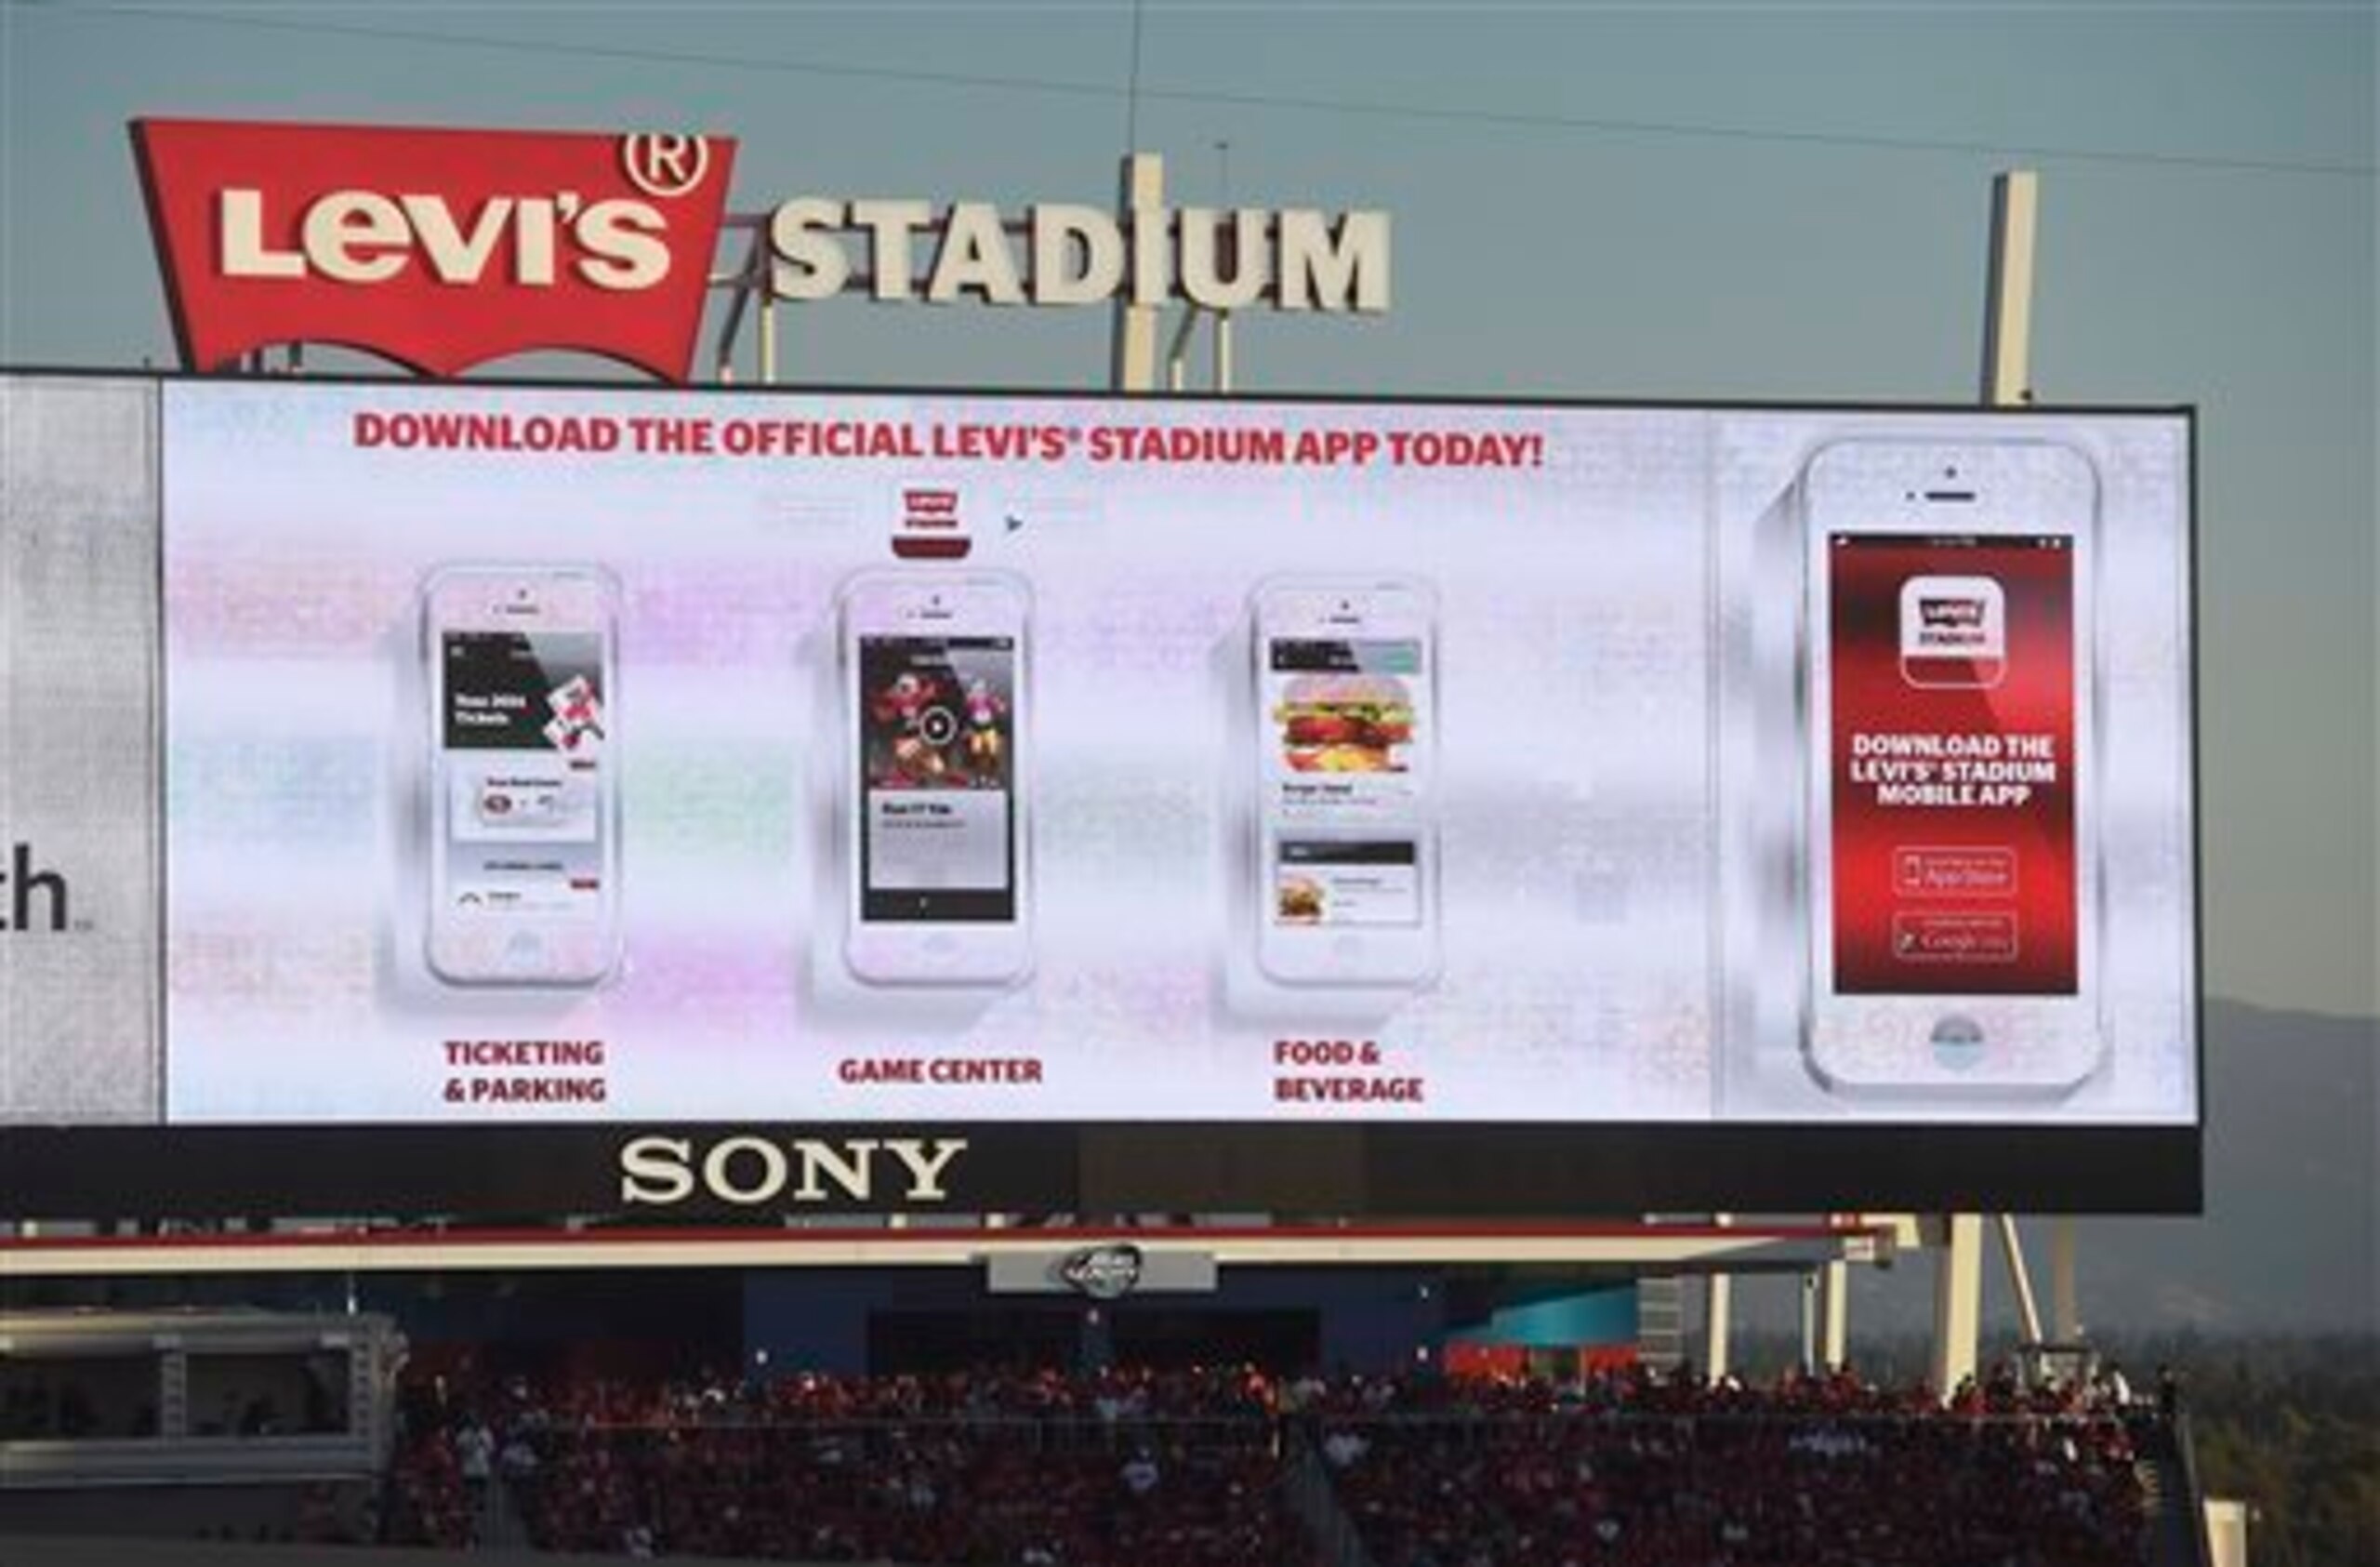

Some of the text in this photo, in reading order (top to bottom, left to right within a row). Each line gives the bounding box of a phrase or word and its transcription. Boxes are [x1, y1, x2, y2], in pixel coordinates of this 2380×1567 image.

[770, 198, 1391, 312] STADIUM
[354, 414, 619, 452] DOWNLOAD
[628, 418, 712, 454] THE
[722, 421, 921, 458] OFFICIAL
[1090, 429, 1284, 464] STADIUM
[1293, 432, 1380, 465] APP
[1389, 433, 1543, 467] TODAY!
[1853, 734, 2055, 757] DOWNLOAD THE
[1942, 762, 2056, 782] STADIUM
[1876, 785, 2032, 806] MOBILE APP
[0, 843, 66, 931] h
[444, 1042, 604, 1066] TICKETING
[1275, 1042, 1381, 1065] FOOD &
[840, 1059, 1042, 1084] GAME CENTER
[444, 1079, 606, 1103] & PARKING
[1275, 1078, 1424, 1102] BEVERAGE
[620, 1137, 968, 1202] SONY
